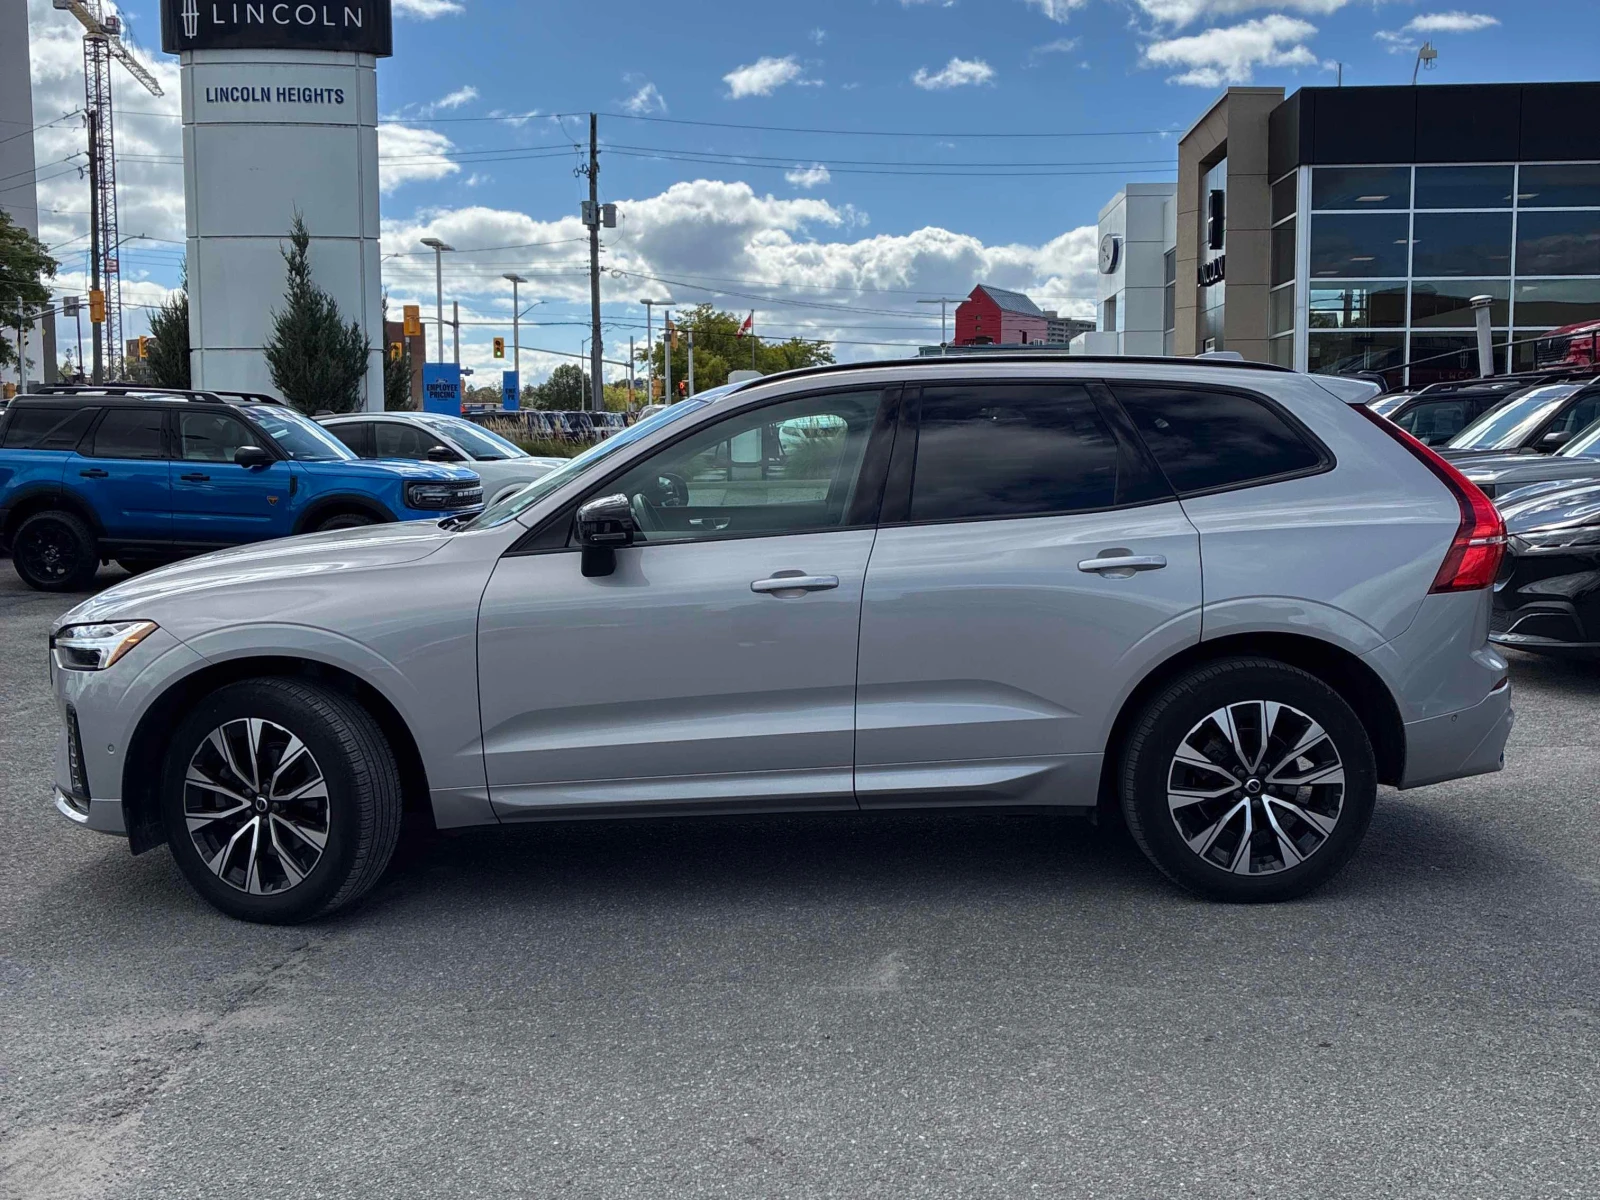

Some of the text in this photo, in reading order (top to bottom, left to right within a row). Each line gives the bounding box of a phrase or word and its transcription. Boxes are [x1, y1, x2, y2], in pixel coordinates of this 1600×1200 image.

[212, 3, 363, 28] LINCOLN
[205, 86, 345, 105] LINCOLN HEIGHTS
[426, 383, 458, 392] EMPLOYEE
[429, 391, 455, 399] PRICING
